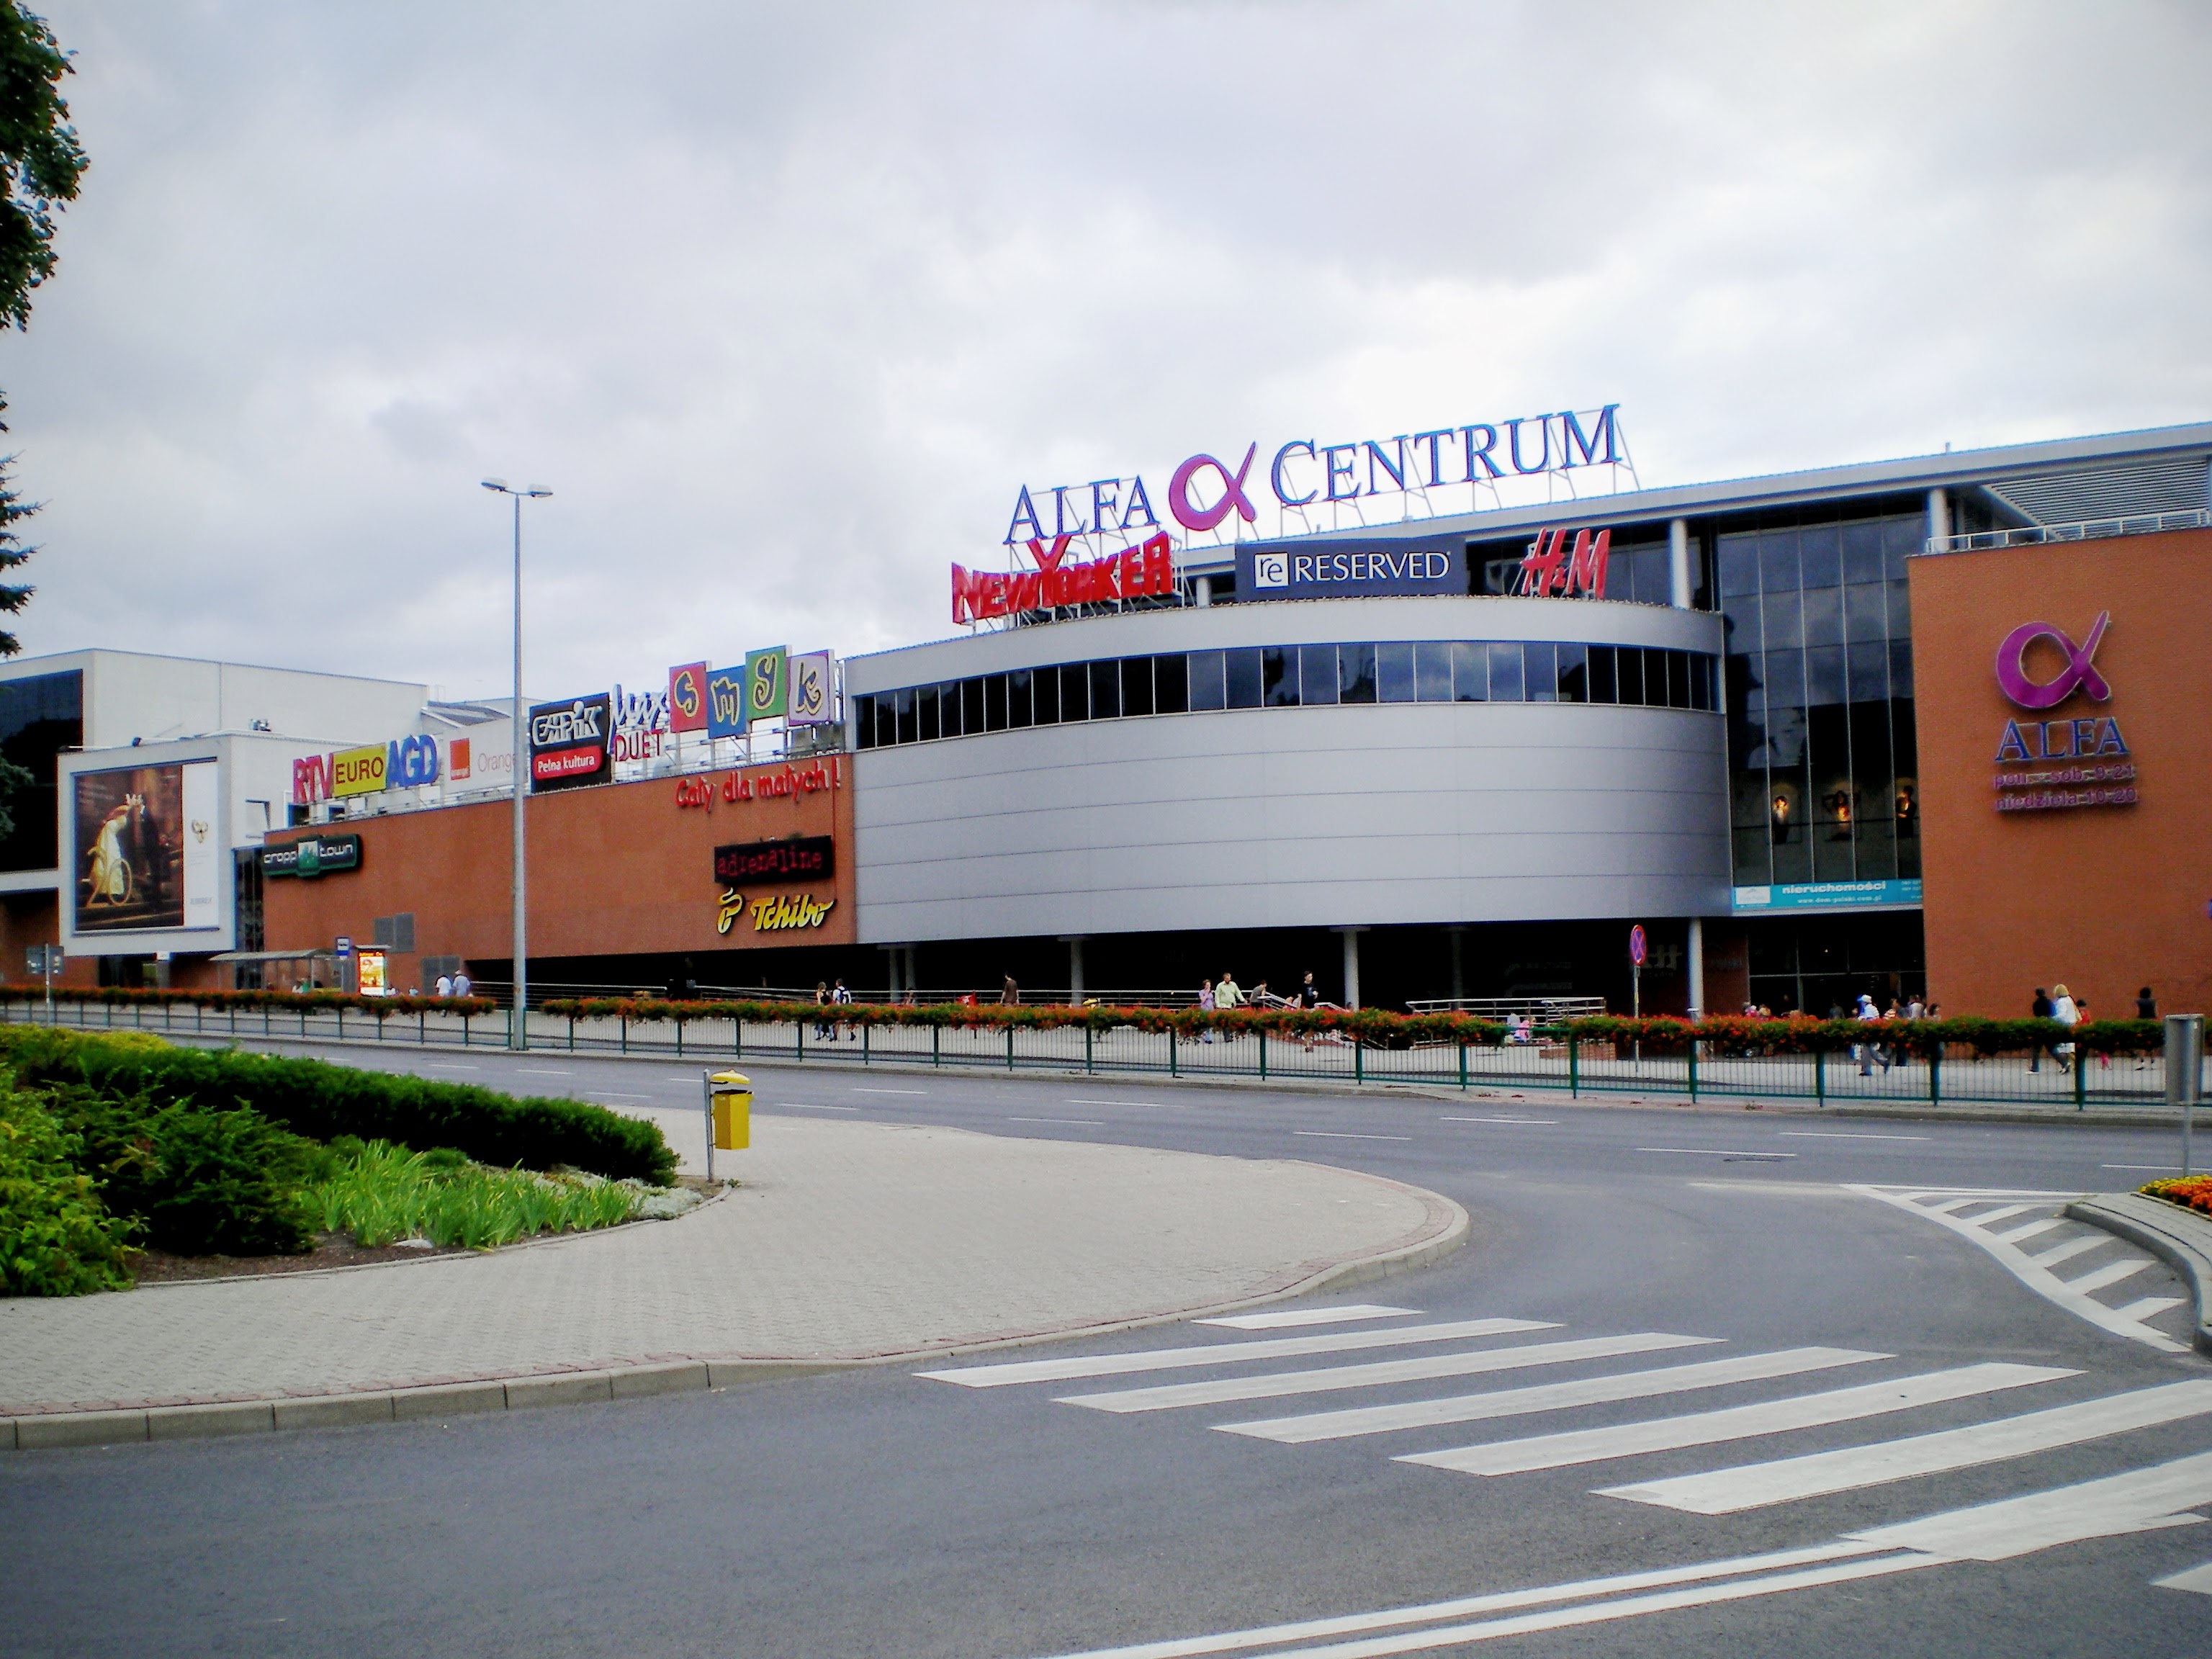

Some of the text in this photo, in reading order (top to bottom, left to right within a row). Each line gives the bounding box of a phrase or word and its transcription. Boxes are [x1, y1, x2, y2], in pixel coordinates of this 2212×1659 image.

[1003, 475, 1160, 545] ALFA
[1271, 403, 1620, 507] CENTRUM
[1295, 552, 1450, 583] RESERVED
[612, 729, 664, 762] DUET
[1994, 716, 2130, 762] ALFA
[292, 734, 439, 804] RTV EURO AGD
[477, 751, 515, 773] Orang
[563, 755, 595, 770] kultura
[722, 770, 753, 803] dla
[1995, 792, 2079, 810] niedziela
[264, 844, 354, 865] cropp town
[717, 845, 822, 877] adrenaline
[1782, 881, 1887, 894] nieruchomości
[750, 894, 834, 931] Tchibo
